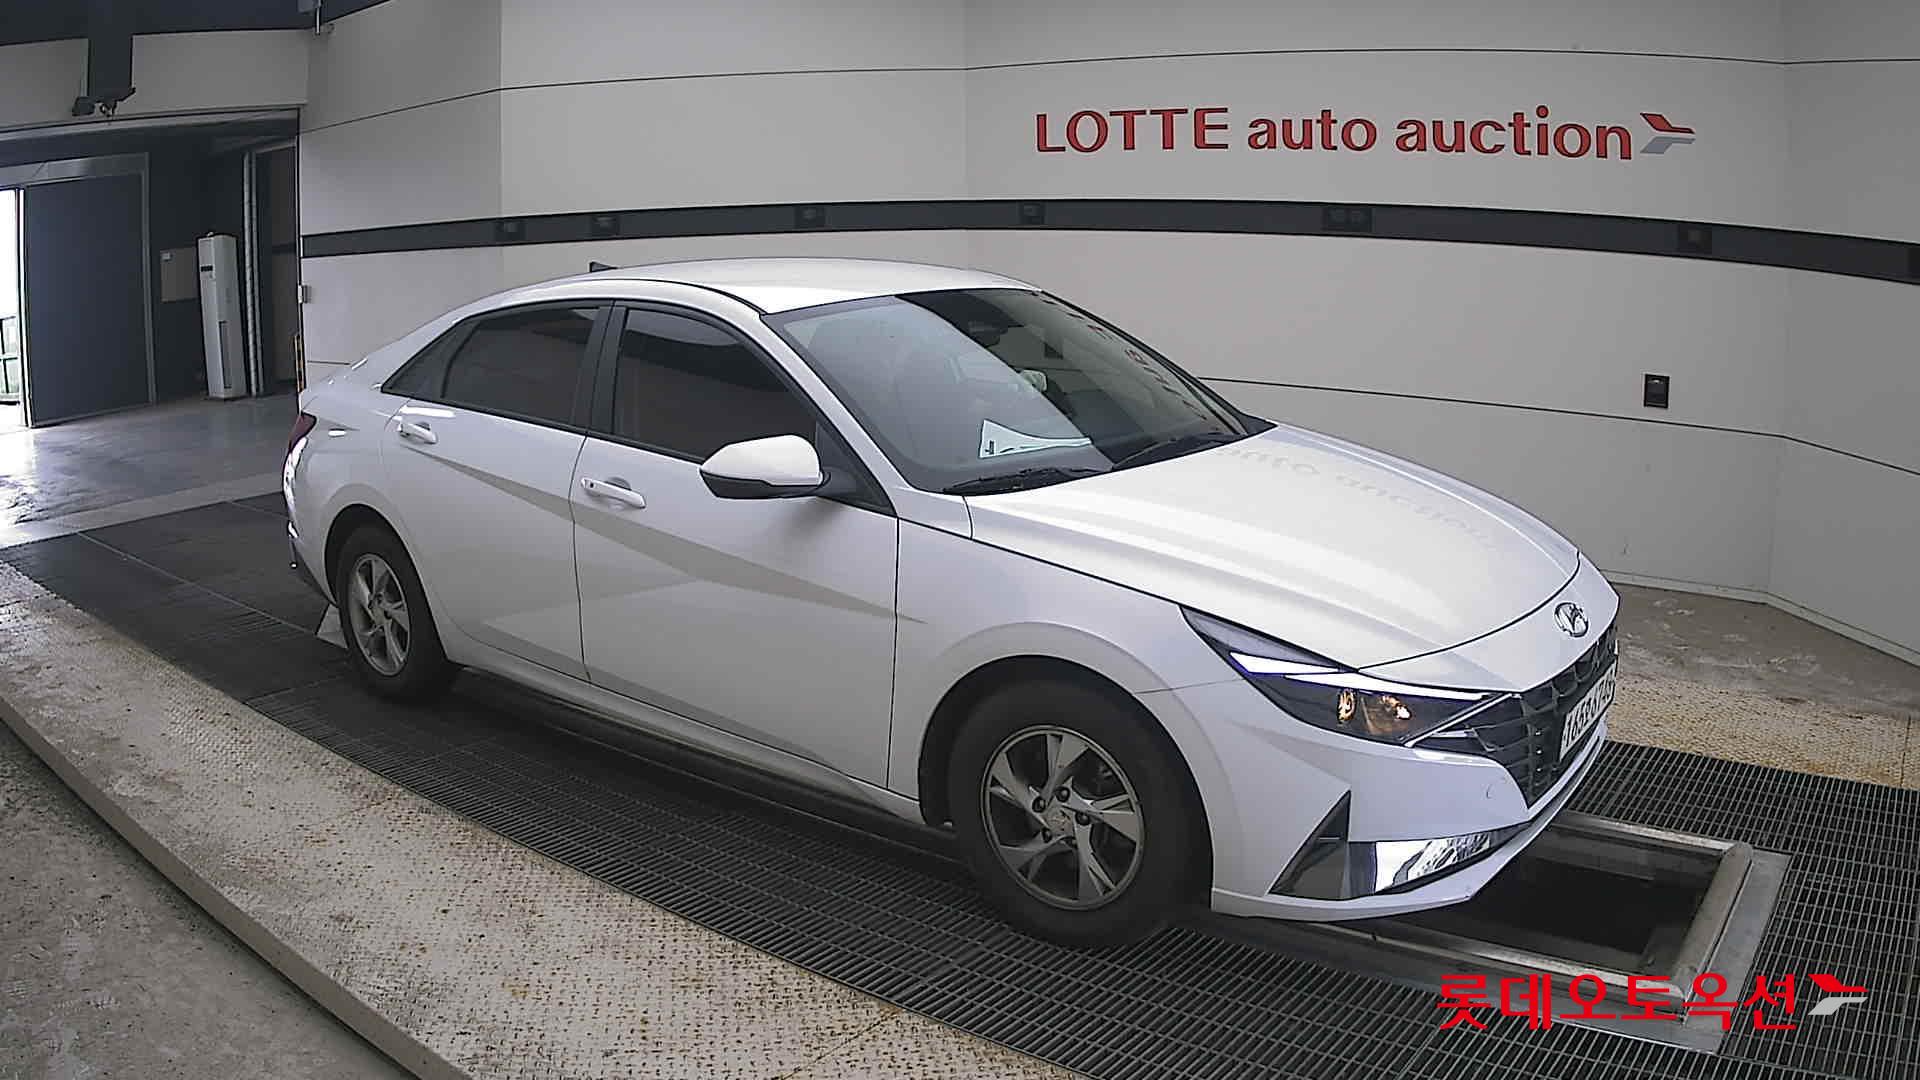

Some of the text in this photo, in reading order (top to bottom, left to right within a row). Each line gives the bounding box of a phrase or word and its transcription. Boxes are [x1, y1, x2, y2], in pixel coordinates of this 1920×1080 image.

[1036, 105, 1634, 160] LOTTE auto auction
